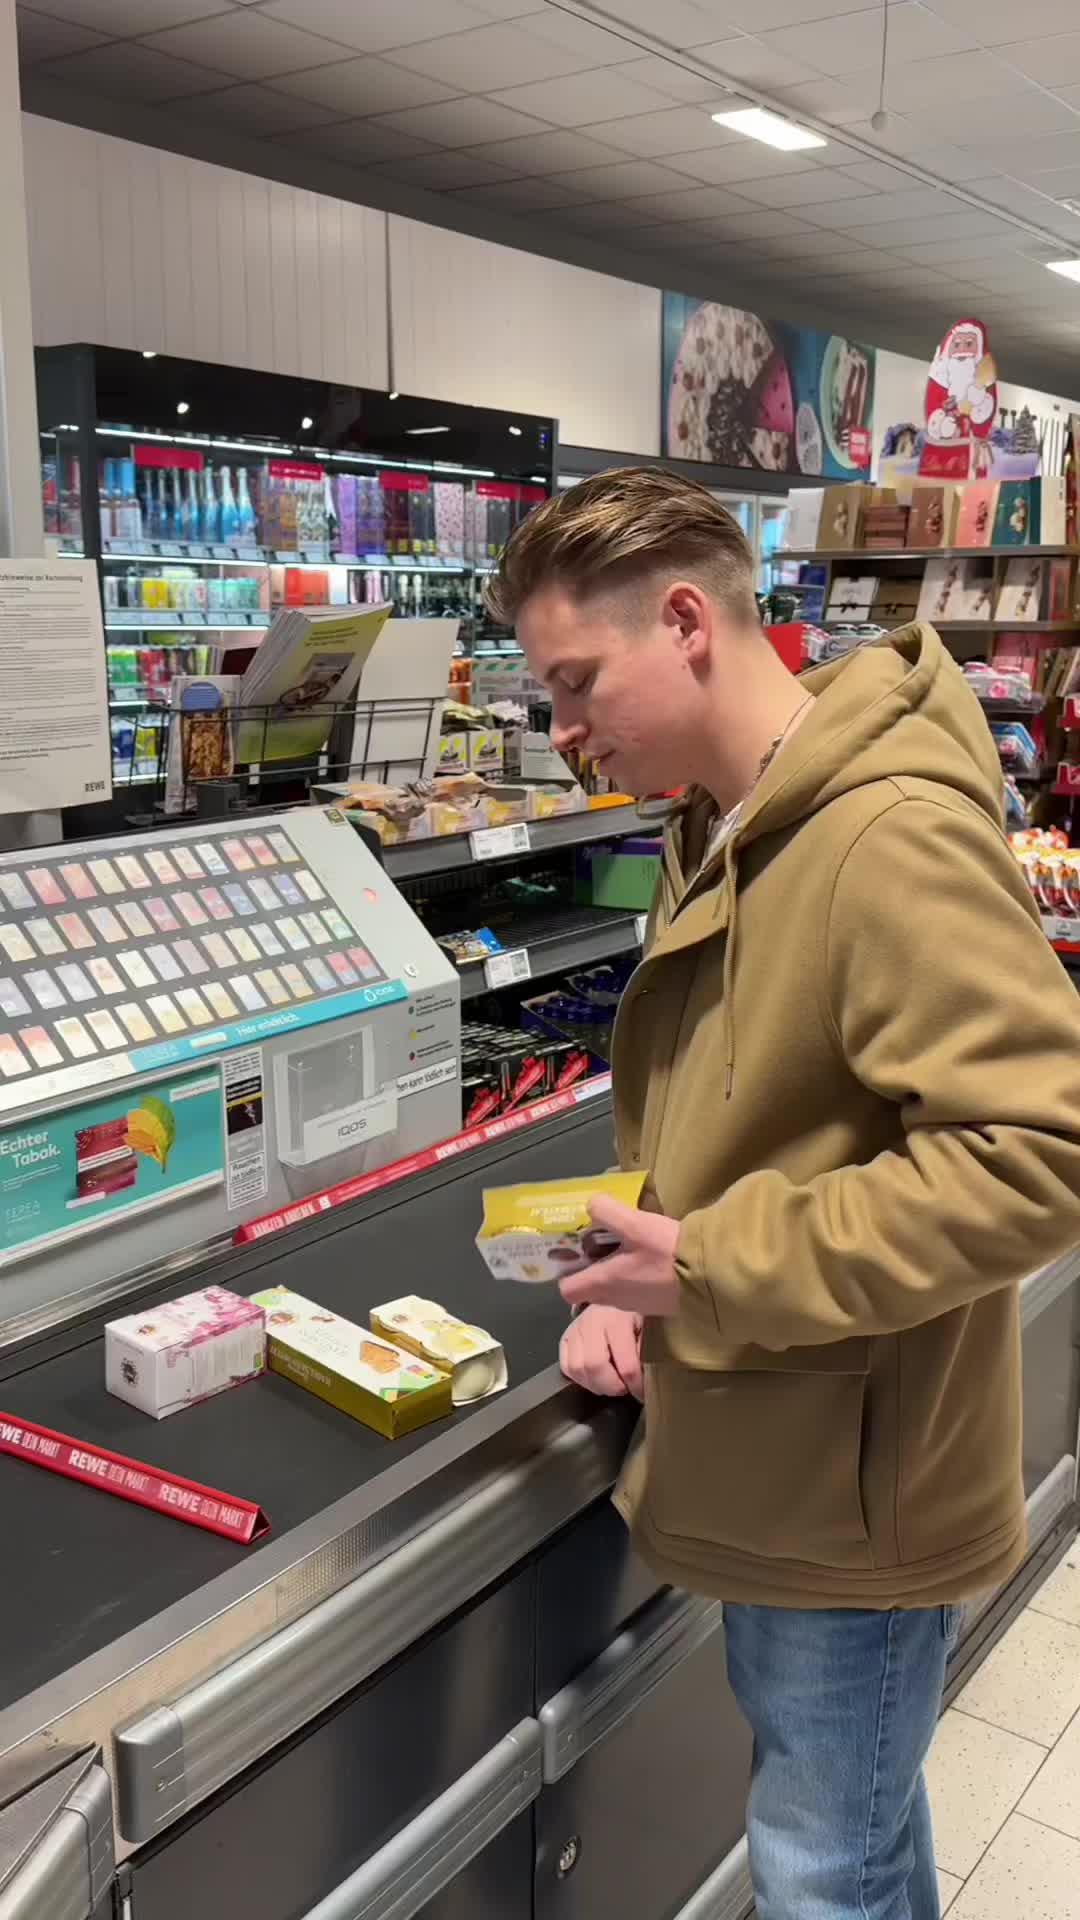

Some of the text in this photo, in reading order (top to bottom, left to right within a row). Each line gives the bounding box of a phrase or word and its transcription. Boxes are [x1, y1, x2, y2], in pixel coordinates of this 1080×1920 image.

[84, 780, 105, 793] REWE
[337, 1118, 367, 1137] IQOS
[0, 1131, 49, 1155] Echter
[12, 1144, 61, 1168] Tabak.
[0, 1422, 61, 1459] WE DEIN MARKT
[69, 1449, 149, 1492] REWE DEIN MARKT
[159, 1483, 244, 1529] REWE DEIN MARKT
